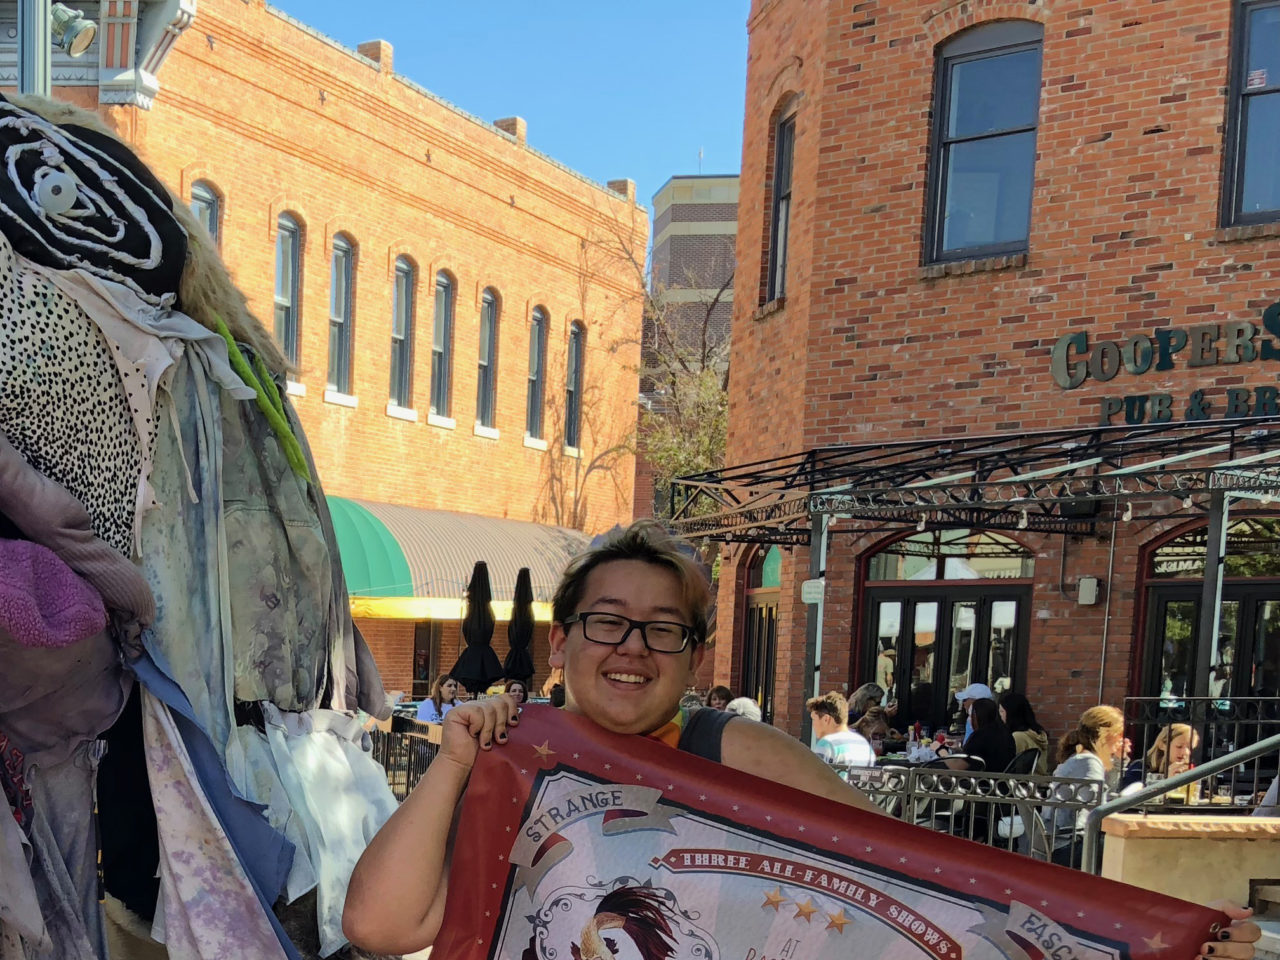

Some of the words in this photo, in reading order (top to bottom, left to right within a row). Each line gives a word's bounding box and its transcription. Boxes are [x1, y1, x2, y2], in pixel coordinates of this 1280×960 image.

[1099, 394, 1173, 427] PUB
[1185, 388, 1212, 421] &
[525, 790, 624, 843] STRANGE
[679, 853, 751, 869] THREE
[756, 859, 884, 908] ALL-FAMILY
[886, 903, 953, 955] SHOWS
[779, 937, 801, 959] AT
